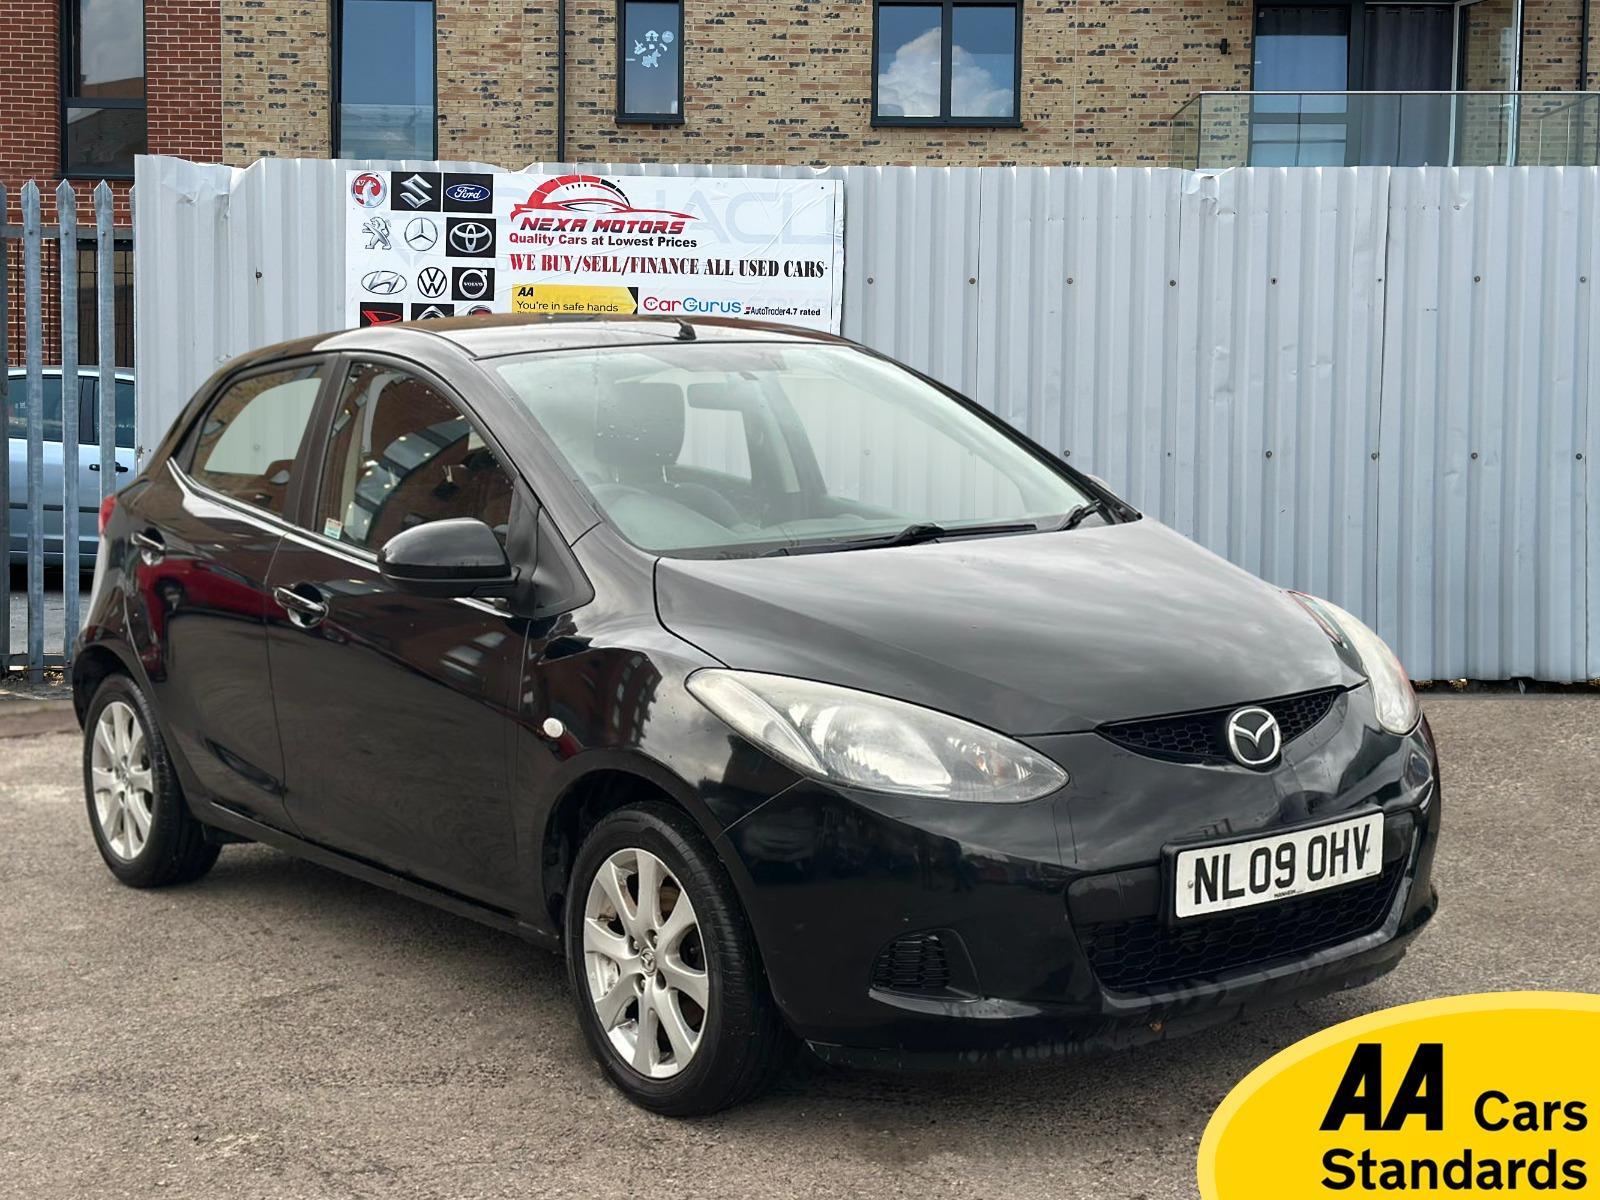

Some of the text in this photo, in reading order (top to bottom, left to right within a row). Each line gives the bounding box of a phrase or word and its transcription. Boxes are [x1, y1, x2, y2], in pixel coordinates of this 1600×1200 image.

[454, 186, 482, 199] Ford
[520, 217, 686, 235] NEXA MOTORS
[509, 233, 697, 248] Quality Cars at Lowest Prices
[510, 254, 536, 271] WE
[704, 259, 734, 276] ALL
[739, 260, 780, 277] USED
[783, 260, 825, 278] CARS
[517, 287, 534, 297] AA
[517, 301, 619, 312] You're in safe hands
[643, 297, 742, 313] CarGurus
[799, 308, 821, 316] rated
[1194, 824, 1370, 905] NL09 OHV
